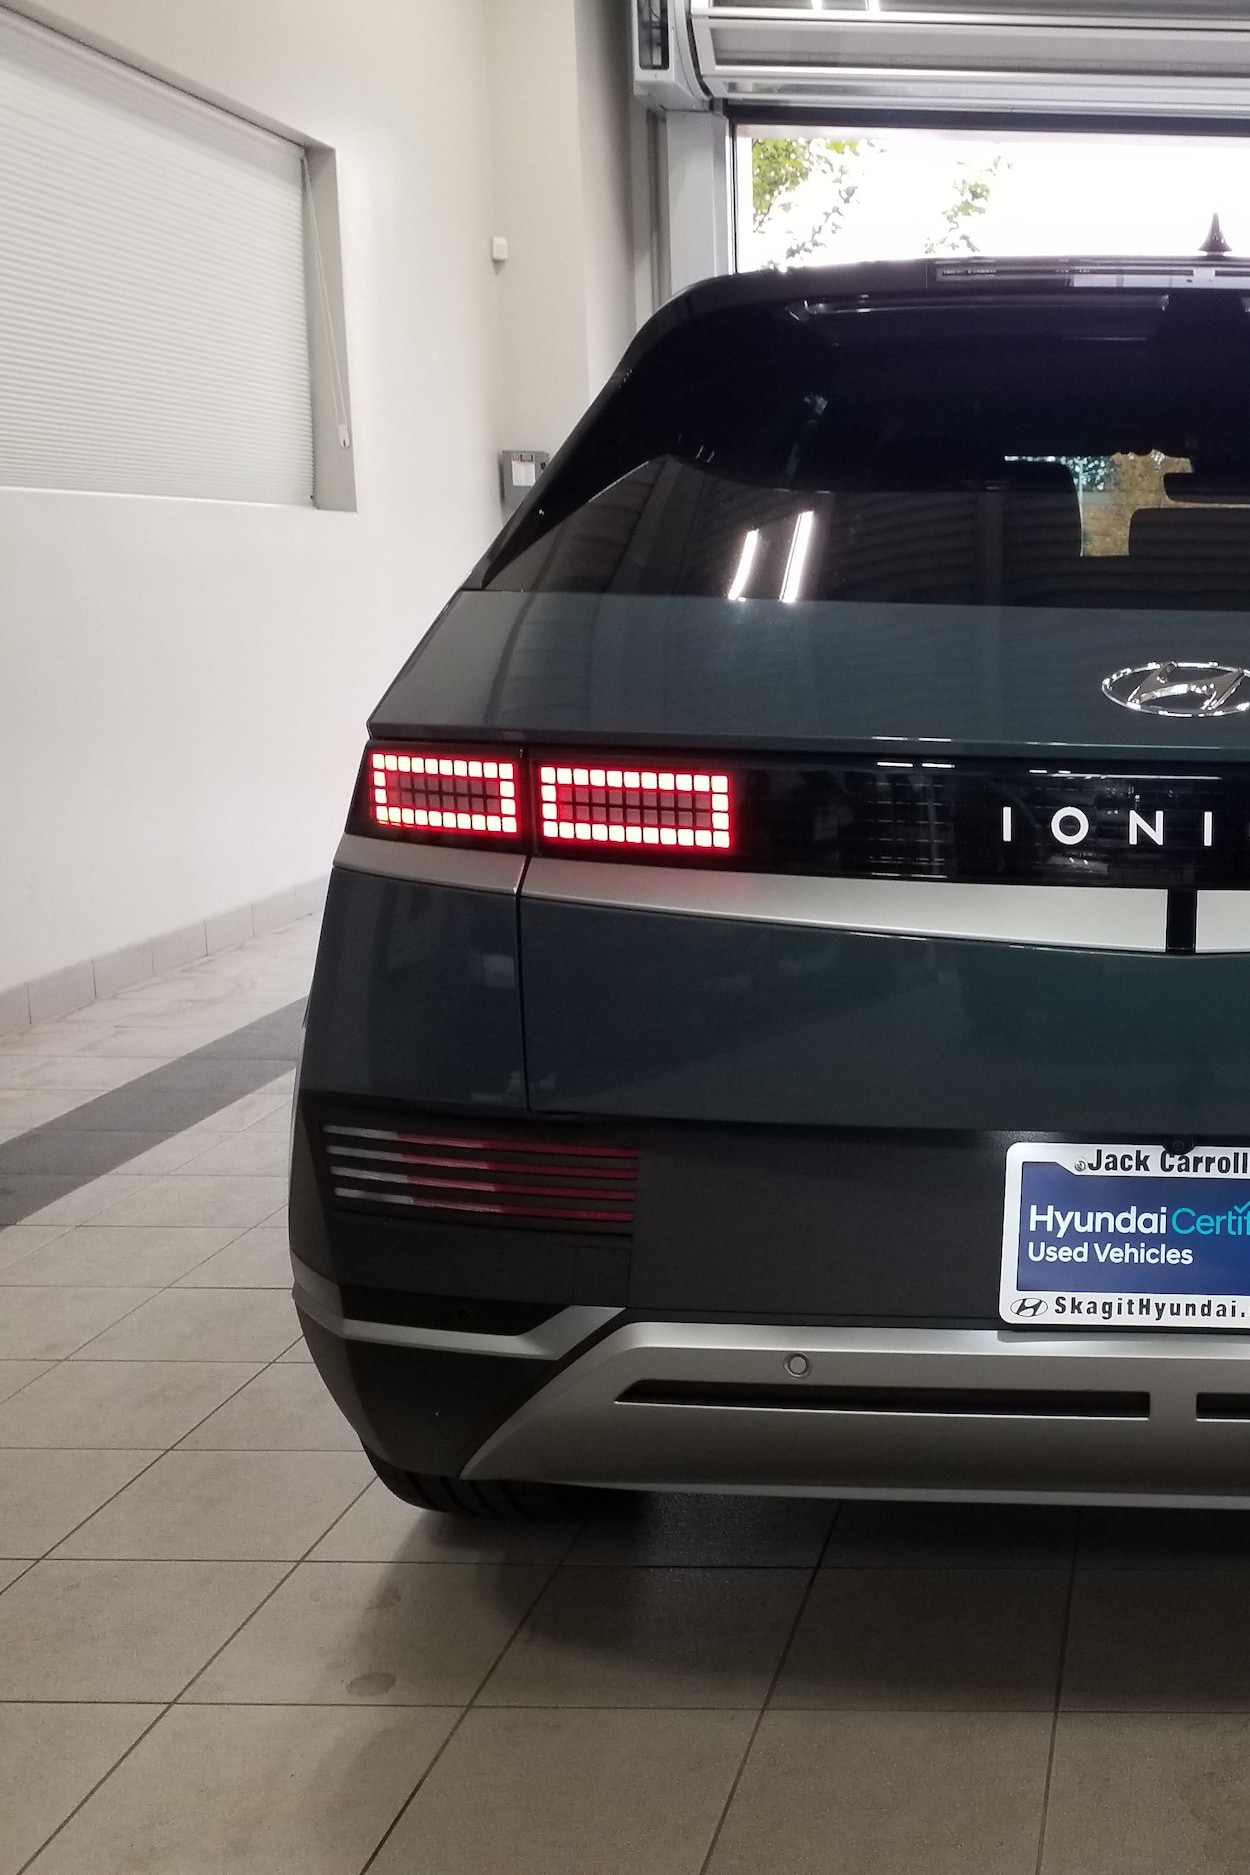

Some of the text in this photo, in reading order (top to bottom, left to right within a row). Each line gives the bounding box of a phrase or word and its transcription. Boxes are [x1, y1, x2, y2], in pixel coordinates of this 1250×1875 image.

[1087, 1149, 1151, 1172] Jack
[1029, 1205, 1167, 1238] Hyundai
[1028, 1241, 1194, 1265] Used Vehicles
